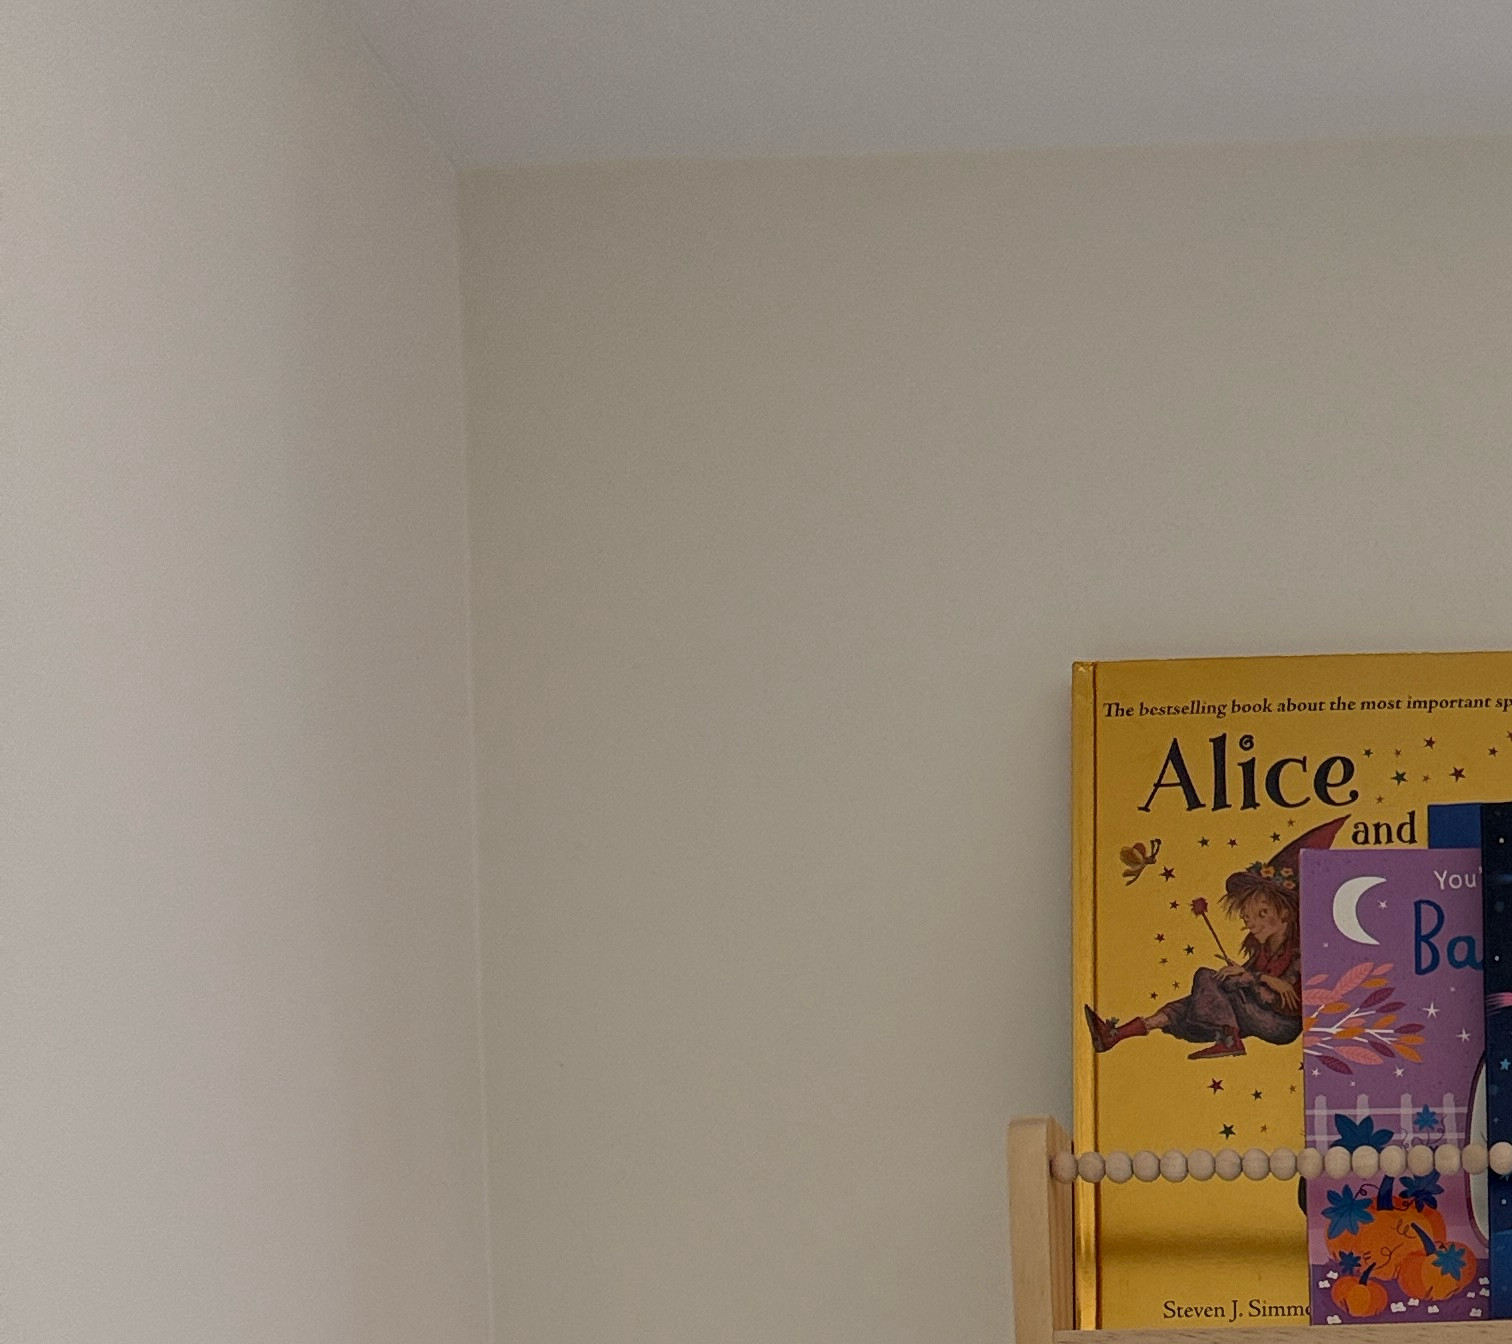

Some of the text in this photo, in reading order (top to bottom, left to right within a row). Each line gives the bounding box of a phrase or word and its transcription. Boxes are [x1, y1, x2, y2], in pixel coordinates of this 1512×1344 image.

[1103, 702, 1135, 718] The
[1139, 699, 1227, 719] bestselling
[1231, 697, 1272, 714] book
[1277, 697, 1325, 713] about
[1329, 696, 1357, 712] the
[1360, 696, 1403, 711] most
[1406, 694, 1490, 713] important
[1138, 732, 1360, 812] Alice
[1351, 811, 1418, 846] and
[1163, 1300, 1226, 1319] Steven
[1228, 1299, 1244, 1323] J.
